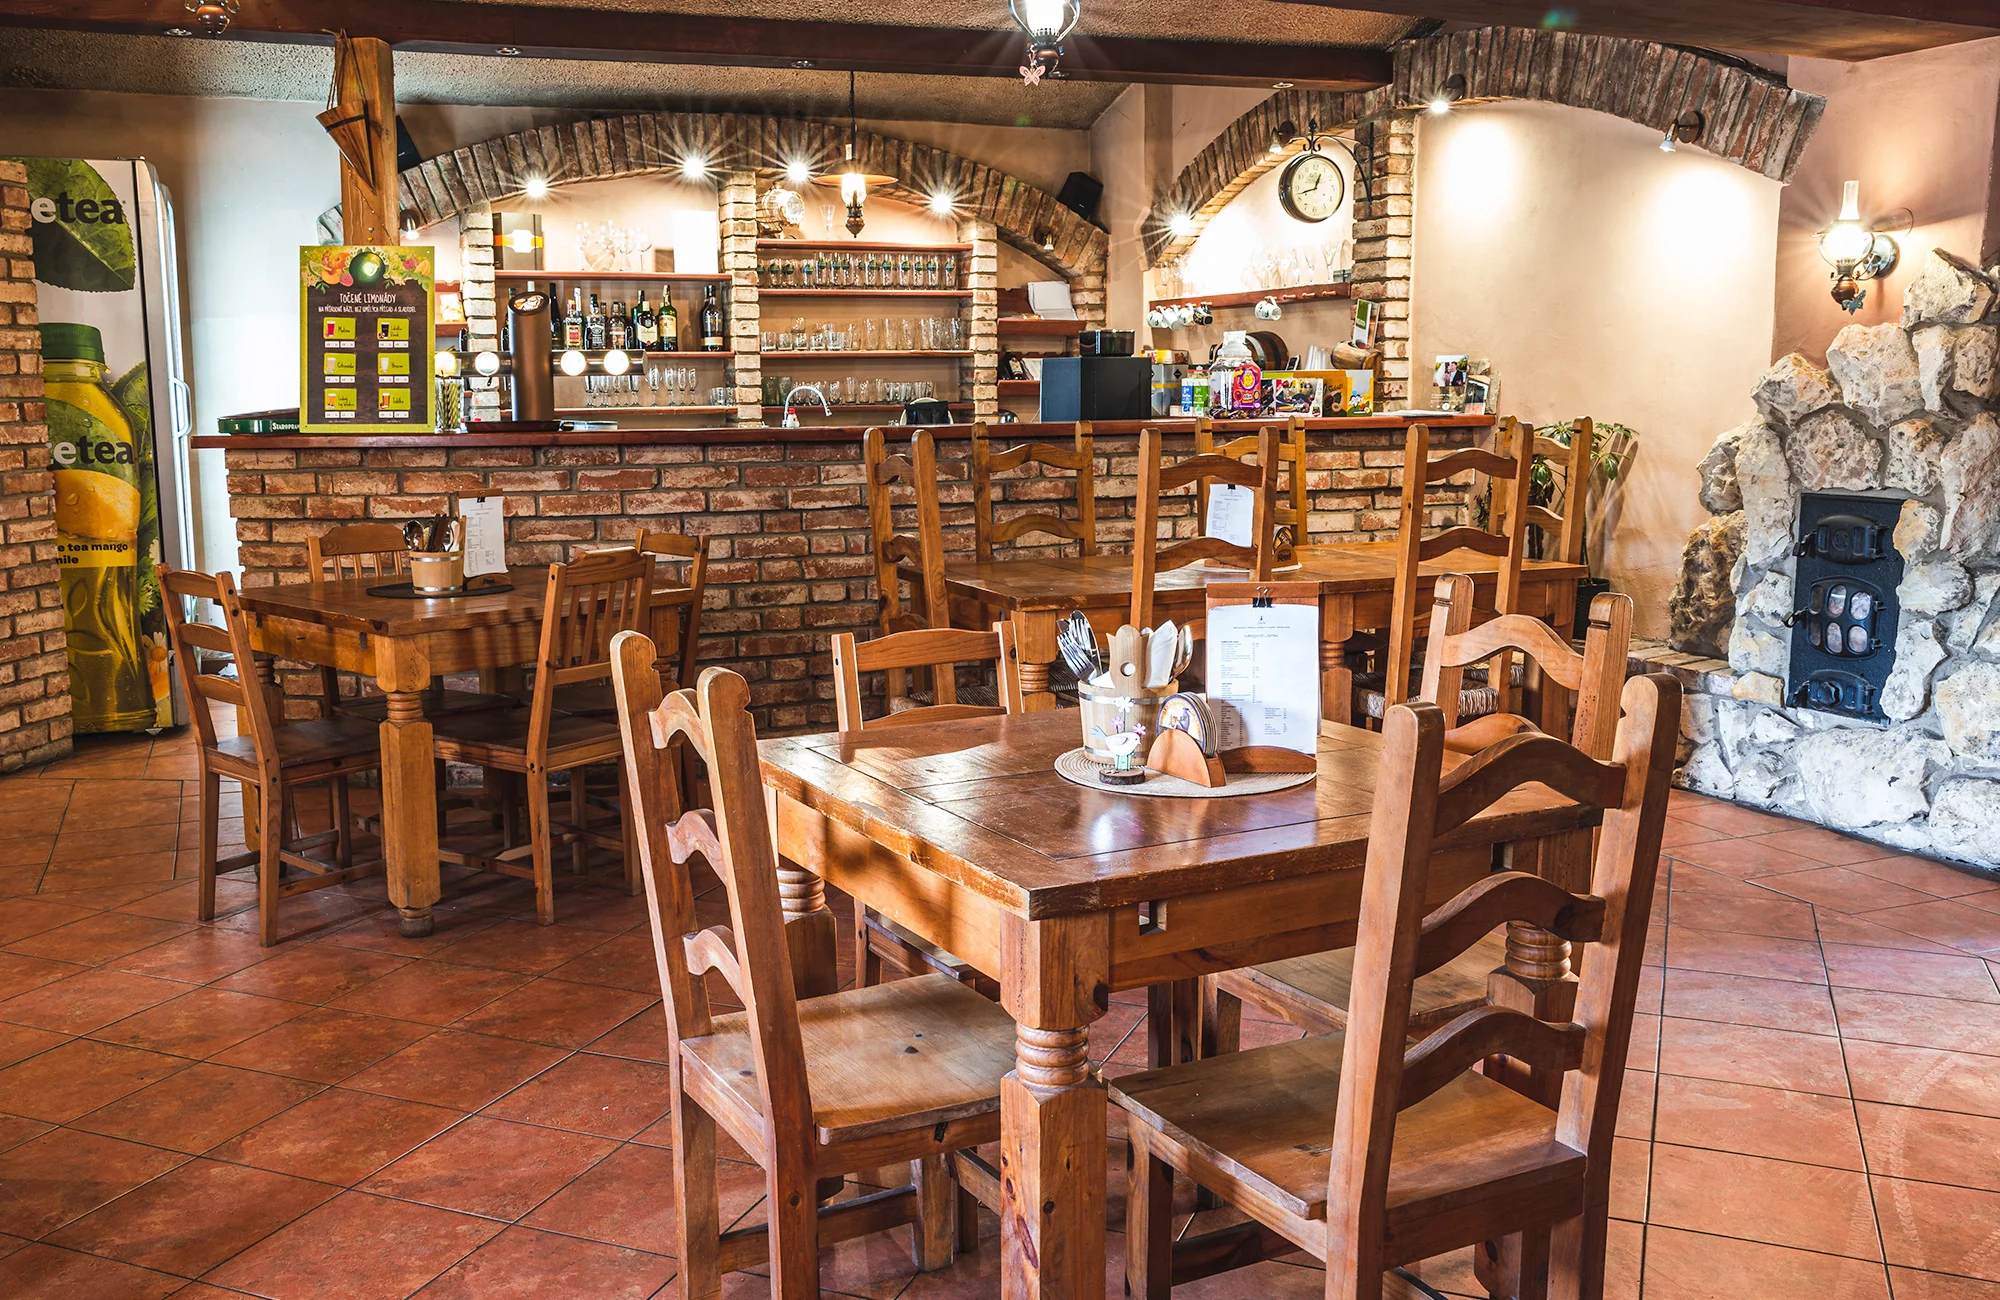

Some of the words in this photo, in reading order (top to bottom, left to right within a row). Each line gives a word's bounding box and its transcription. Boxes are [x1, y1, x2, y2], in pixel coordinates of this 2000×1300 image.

[340, 292, 362, 303] TOČENÉ
[363, 292, 396, 303] LIMONÁDY
[45, 435, 135, 465] etea
[68, 543, 88, 551] tea
[91, 542, 128, 552] mango
